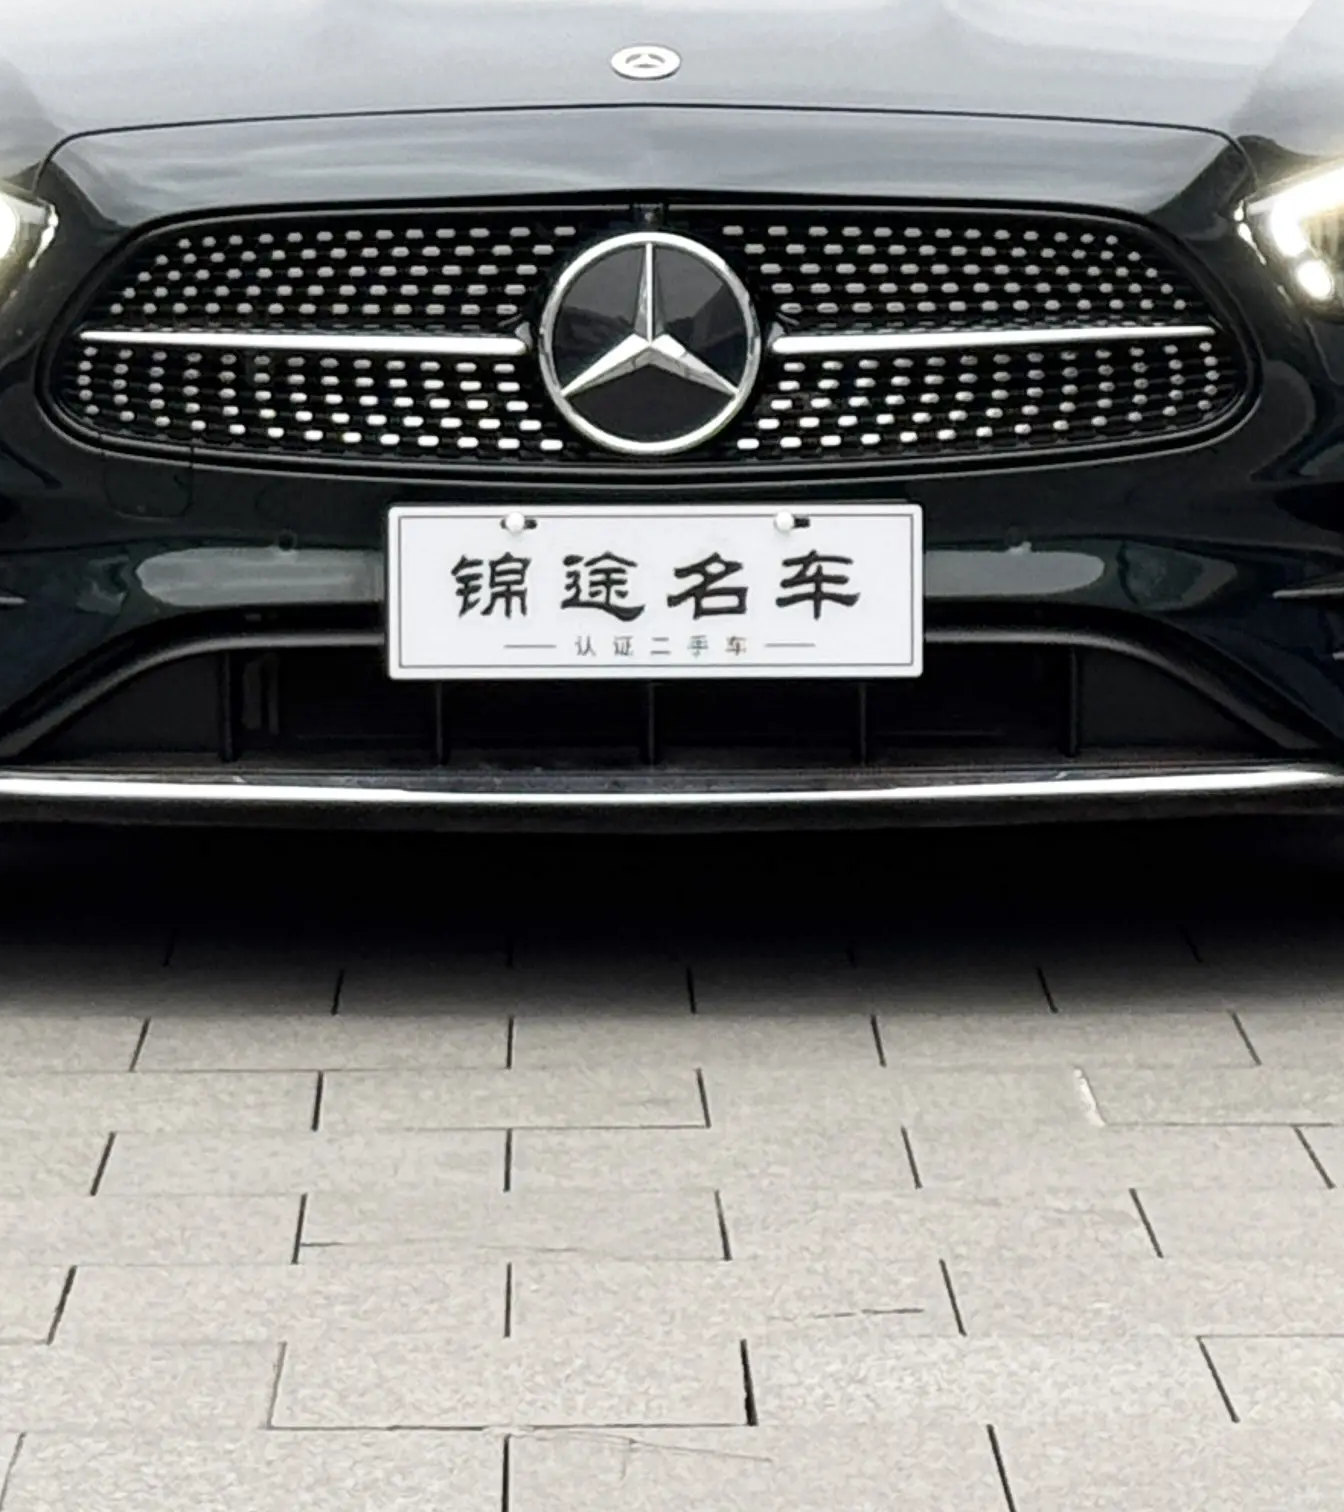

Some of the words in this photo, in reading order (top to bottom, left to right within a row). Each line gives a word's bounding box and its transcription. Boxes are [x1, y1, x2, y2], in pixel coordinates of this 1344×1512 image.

[451, 549, 861, 622] 锦途名车
[574, 635, 747, 657] 认证二手车
